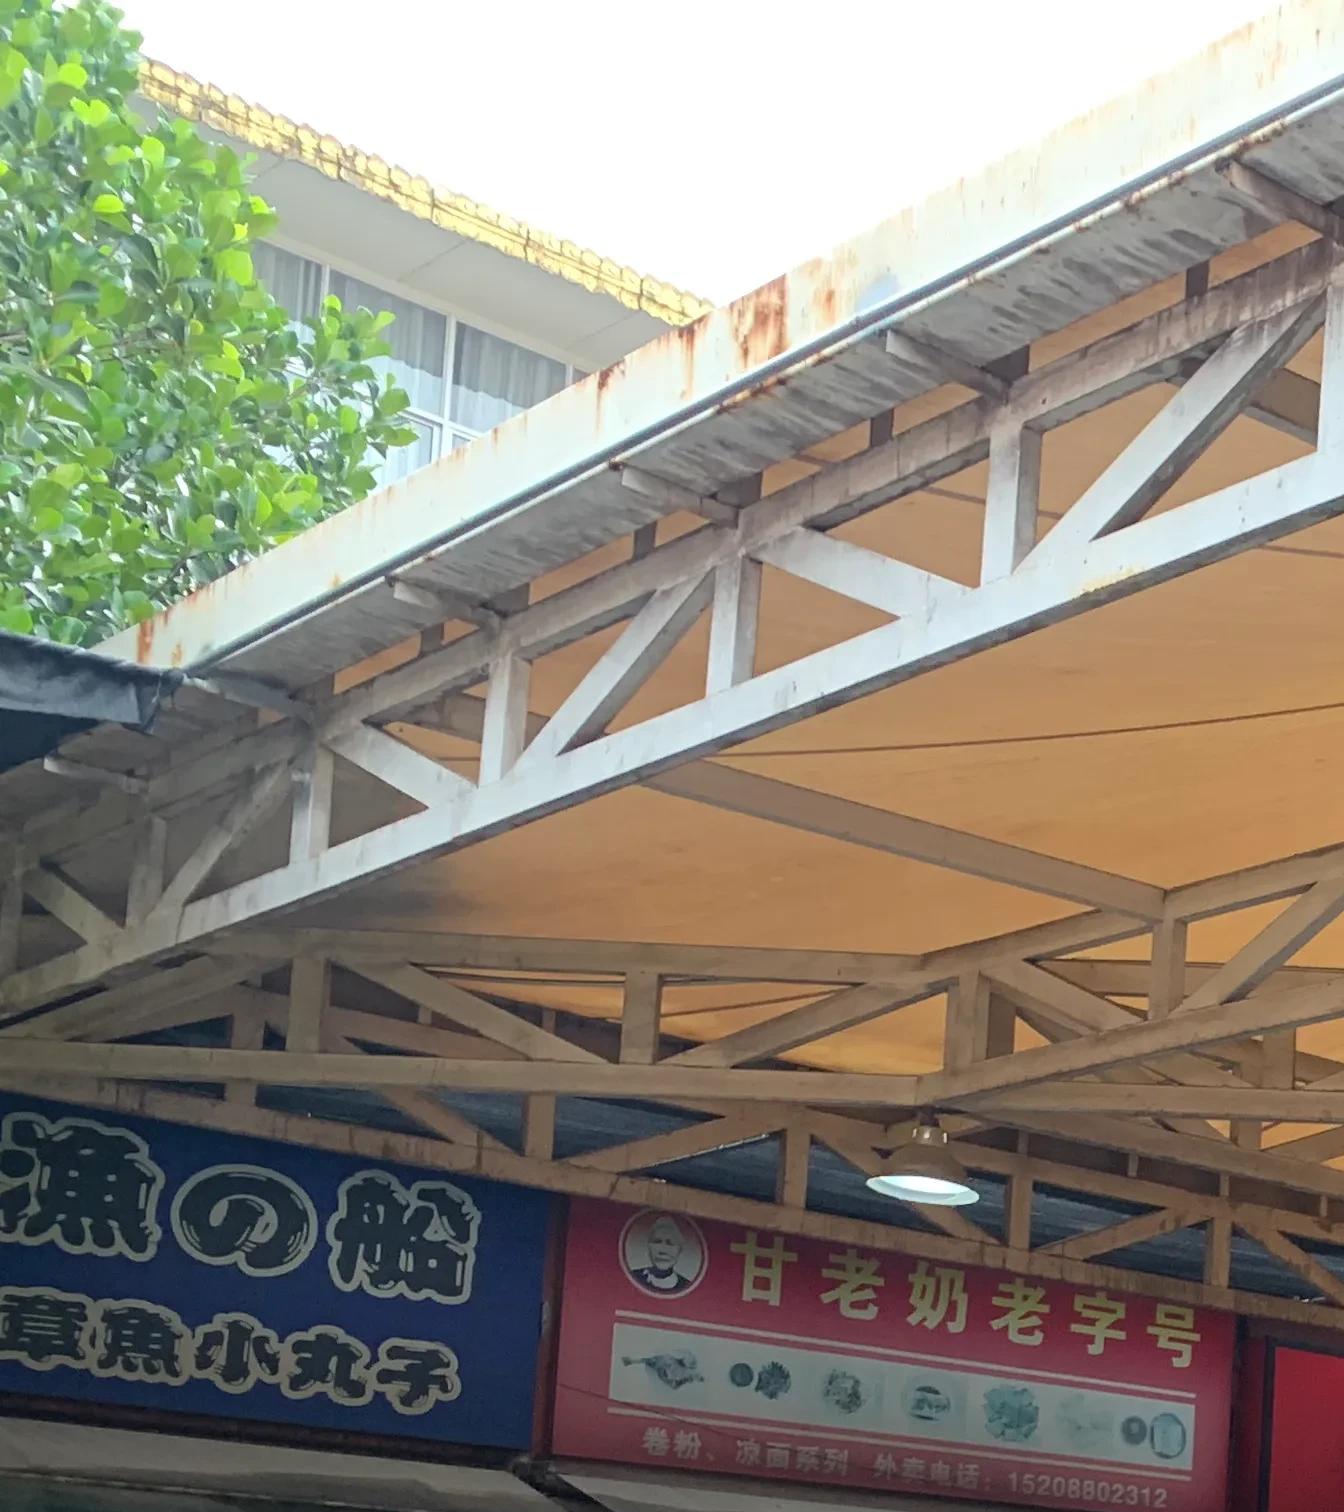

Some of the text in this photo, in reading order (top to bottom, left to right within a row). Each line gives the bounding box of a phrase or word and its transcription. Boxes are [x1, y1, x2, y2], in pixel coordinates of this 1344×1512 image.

[0, 1287, 461, 1414] 章魚小丸子
[729, 1231, 1202, 1369] 甘老奶老字号
[1008, 1472, 1168, 1508] 15208802312
